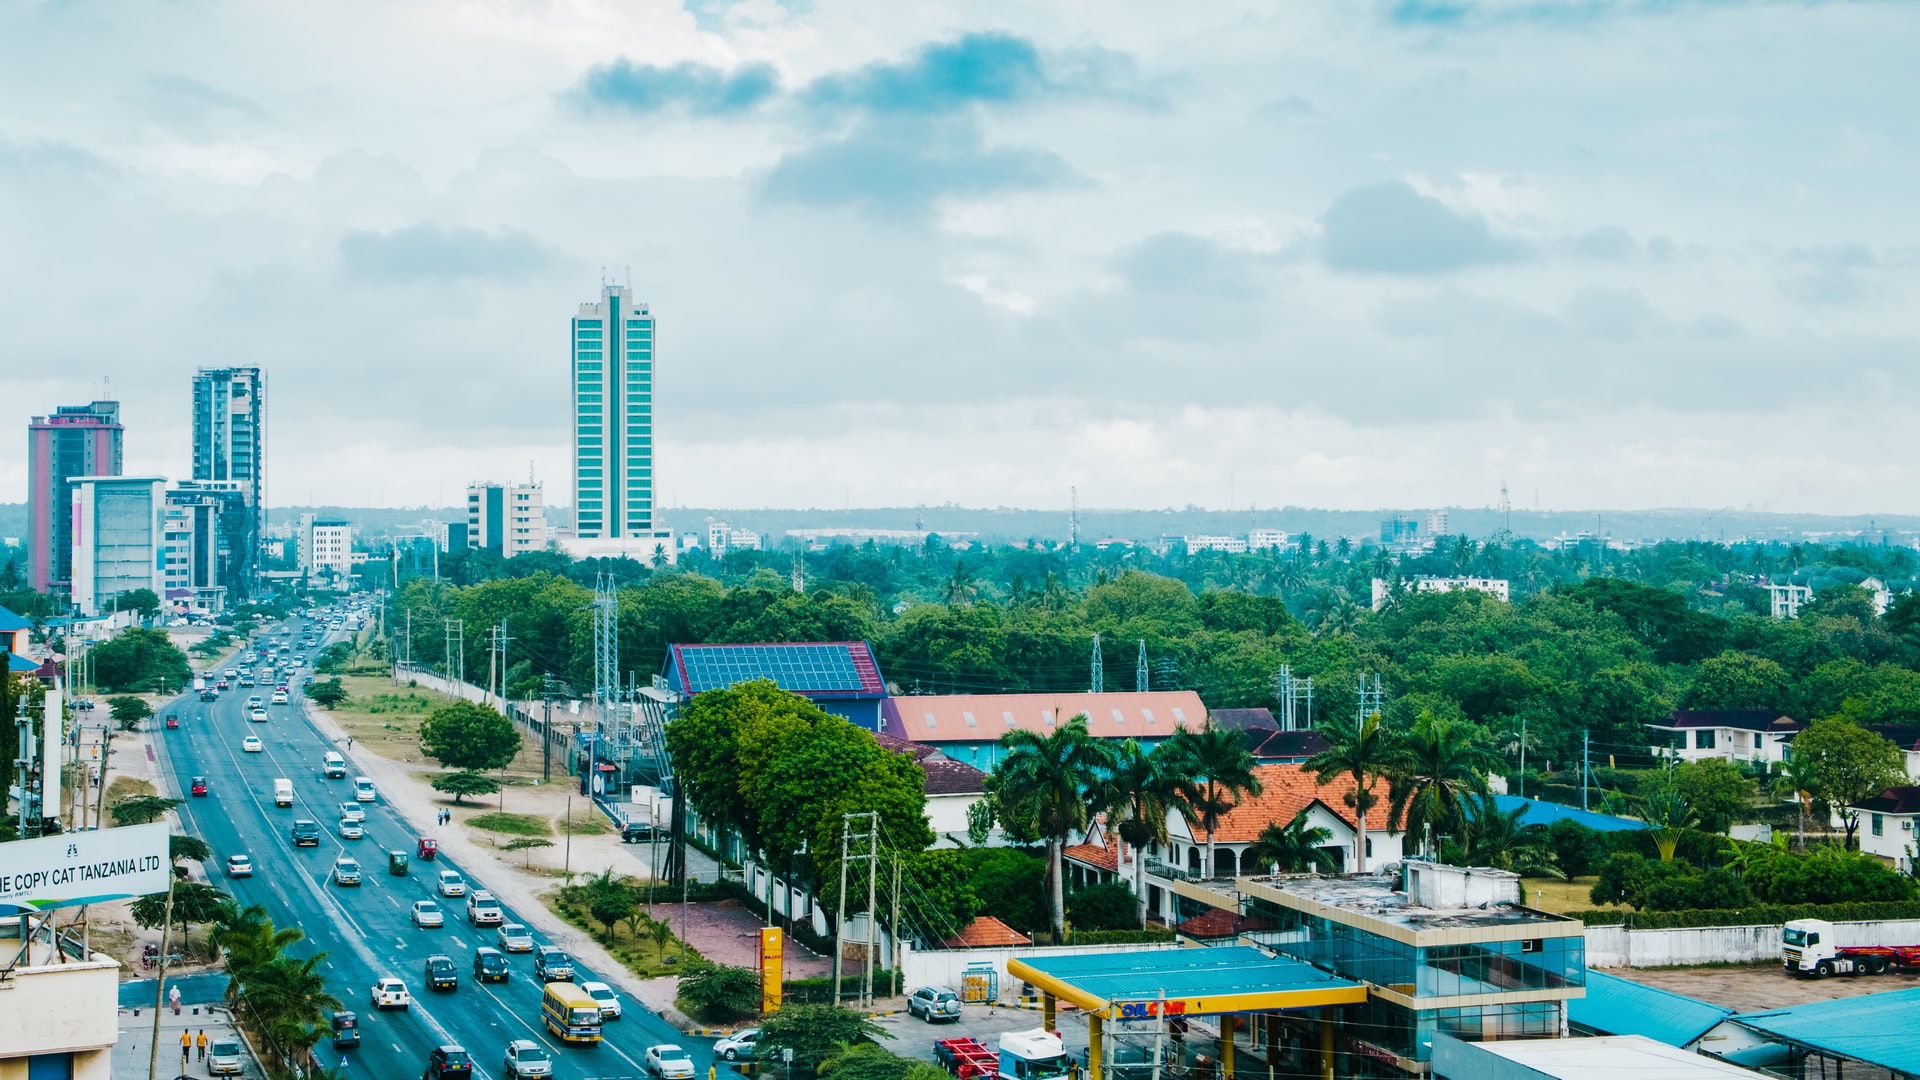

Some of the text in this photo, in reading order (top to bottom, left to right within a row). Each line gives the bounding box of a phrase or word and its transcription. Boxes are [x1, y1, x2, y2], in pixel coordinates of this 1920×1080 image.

[0, 855, 160, 893] E COPY CAT TANZANIA LTD
[1122, 1001, 1185, 1017] OILCOM
